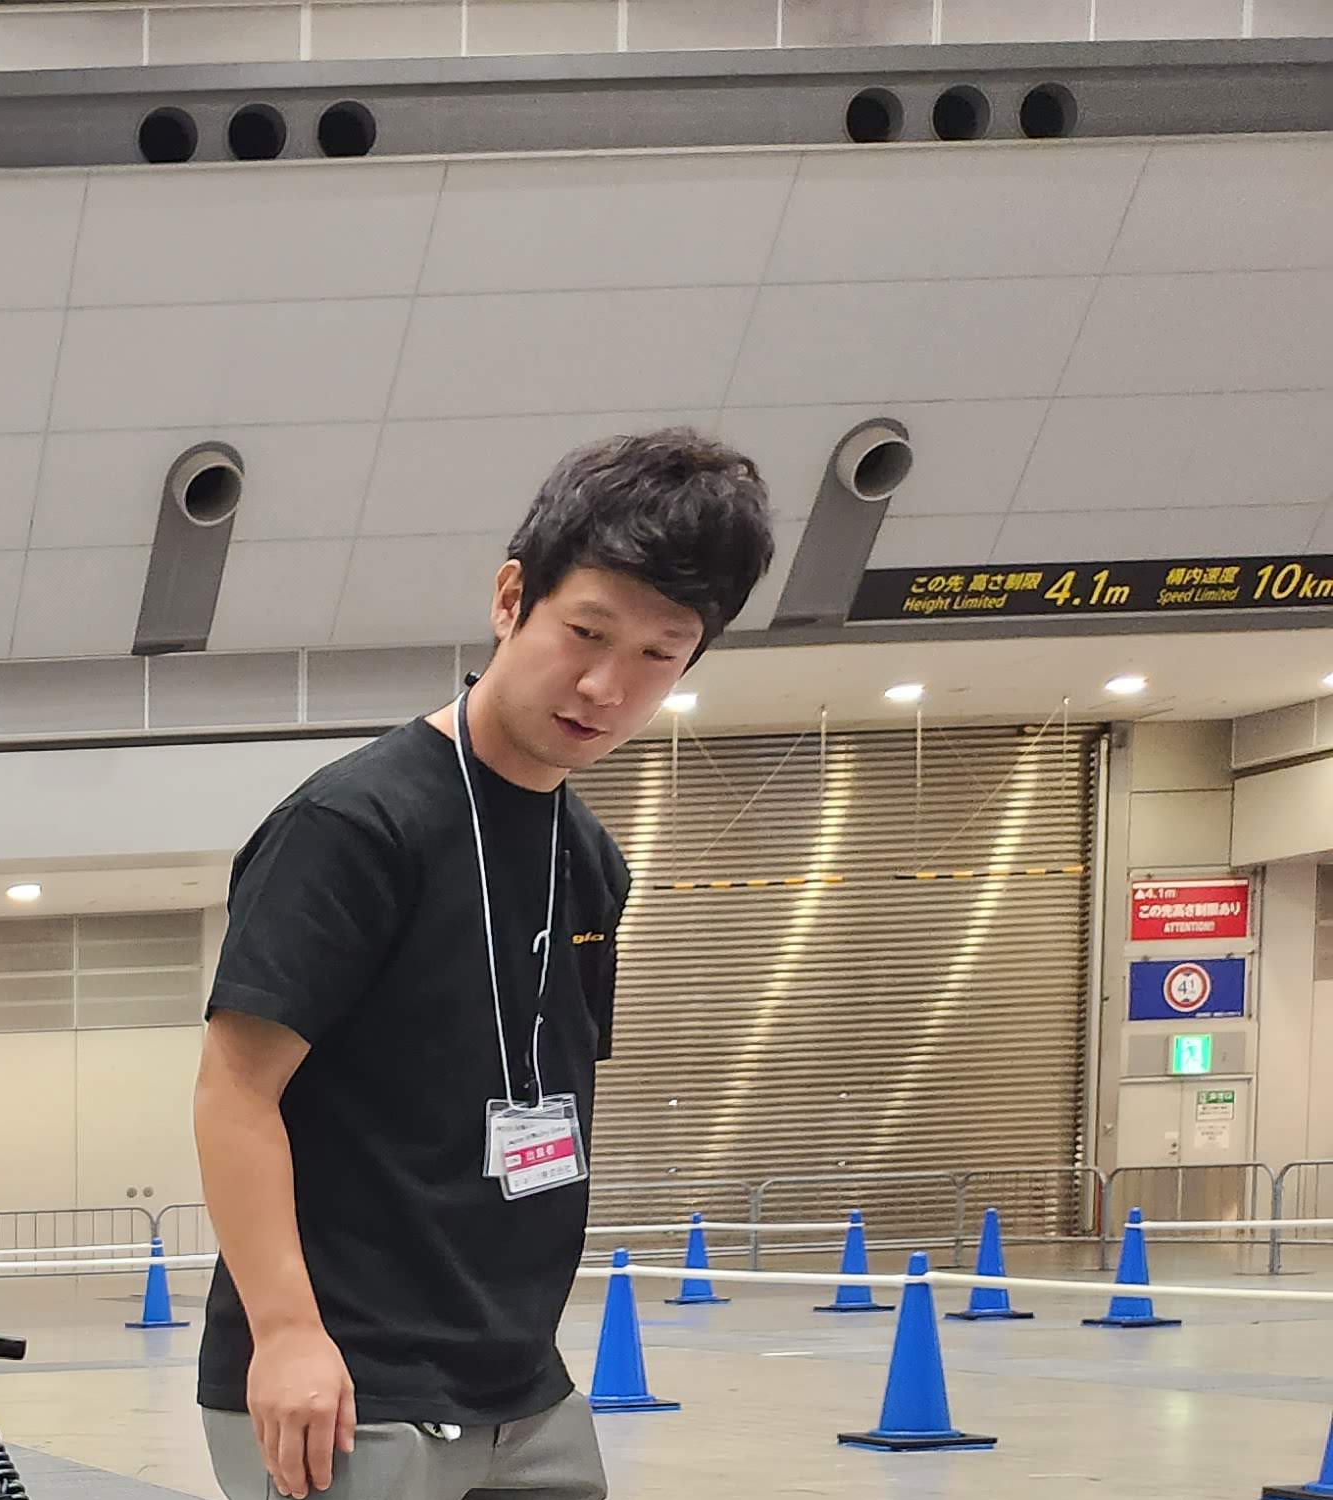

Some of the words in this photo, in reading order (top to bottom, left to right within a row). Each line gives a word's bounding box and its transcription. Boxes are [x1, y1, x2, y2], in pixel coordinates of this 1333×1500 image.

[910, 574, 964, 593] この先
[968, 572, 1044, 592] 高さ制限
[1044, 569, 1130, 607] 4.1m
[902, 597, 950, 614] Height
[952, 593, 1009, 610] Limited
[1157, 587, 1195, 606] Speed
[1194, 586, 1241, 602] Limited
[572, 931, 605, 944] gla
